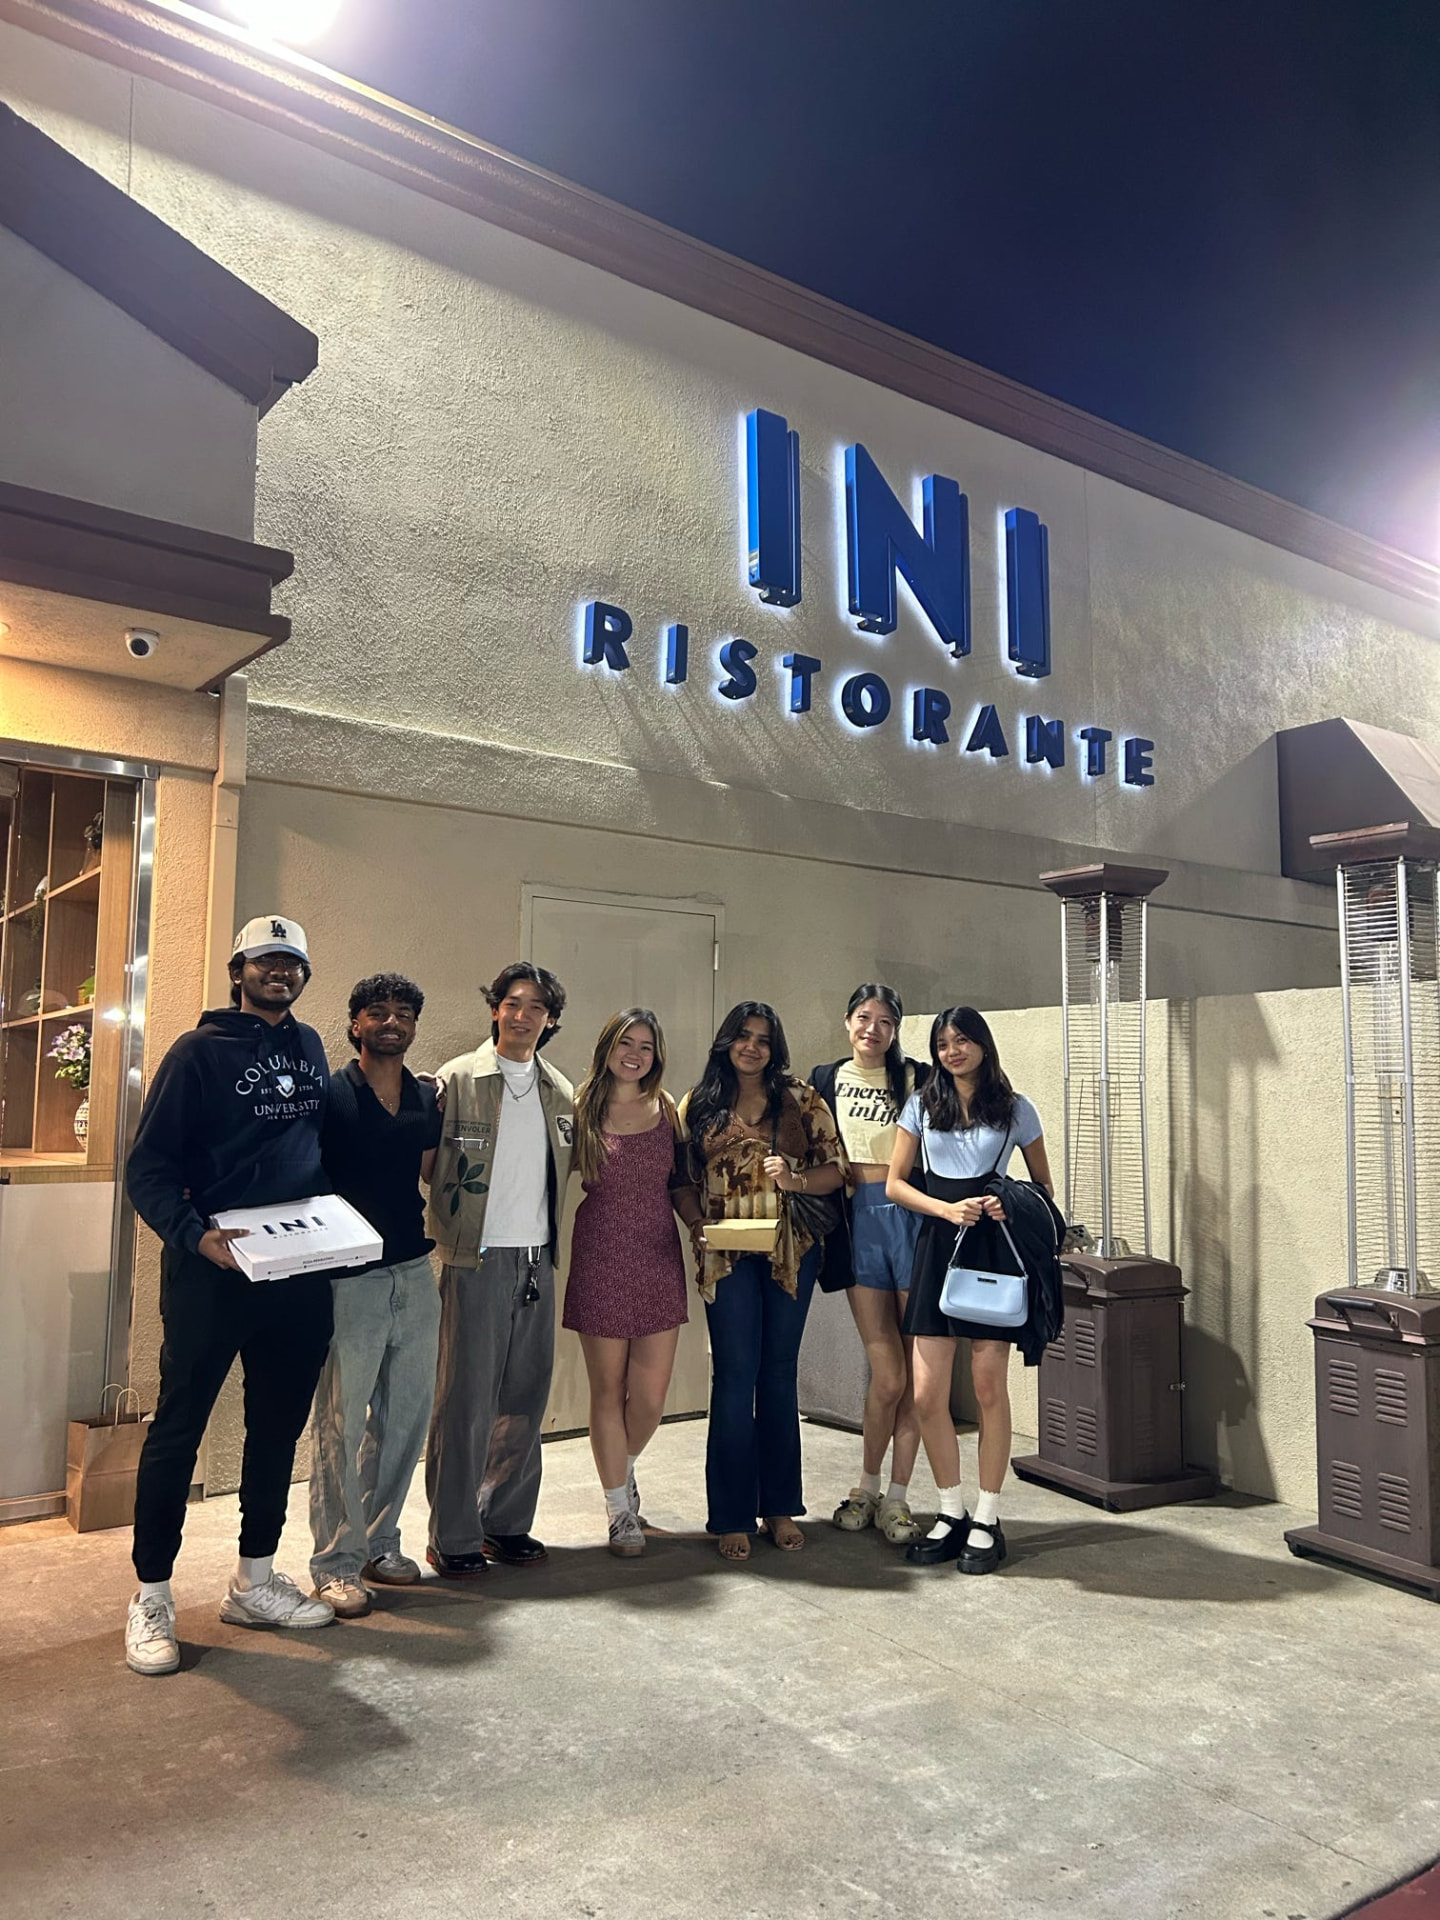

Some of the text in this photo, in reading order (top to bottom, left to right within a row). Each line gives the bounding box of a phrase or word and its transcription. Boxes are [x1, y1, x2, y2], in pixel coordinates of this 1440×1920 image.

[746, 408, 1051, 678] INI
[583, 601, 1154, 787] RISTORANTE
[270, 920, 287, 938] LA
[235, 1054, 323, 1096] COLUMBIA
[835, 1082, 894, 1106] Energ
[262, 1216, 326, 1235] INI
